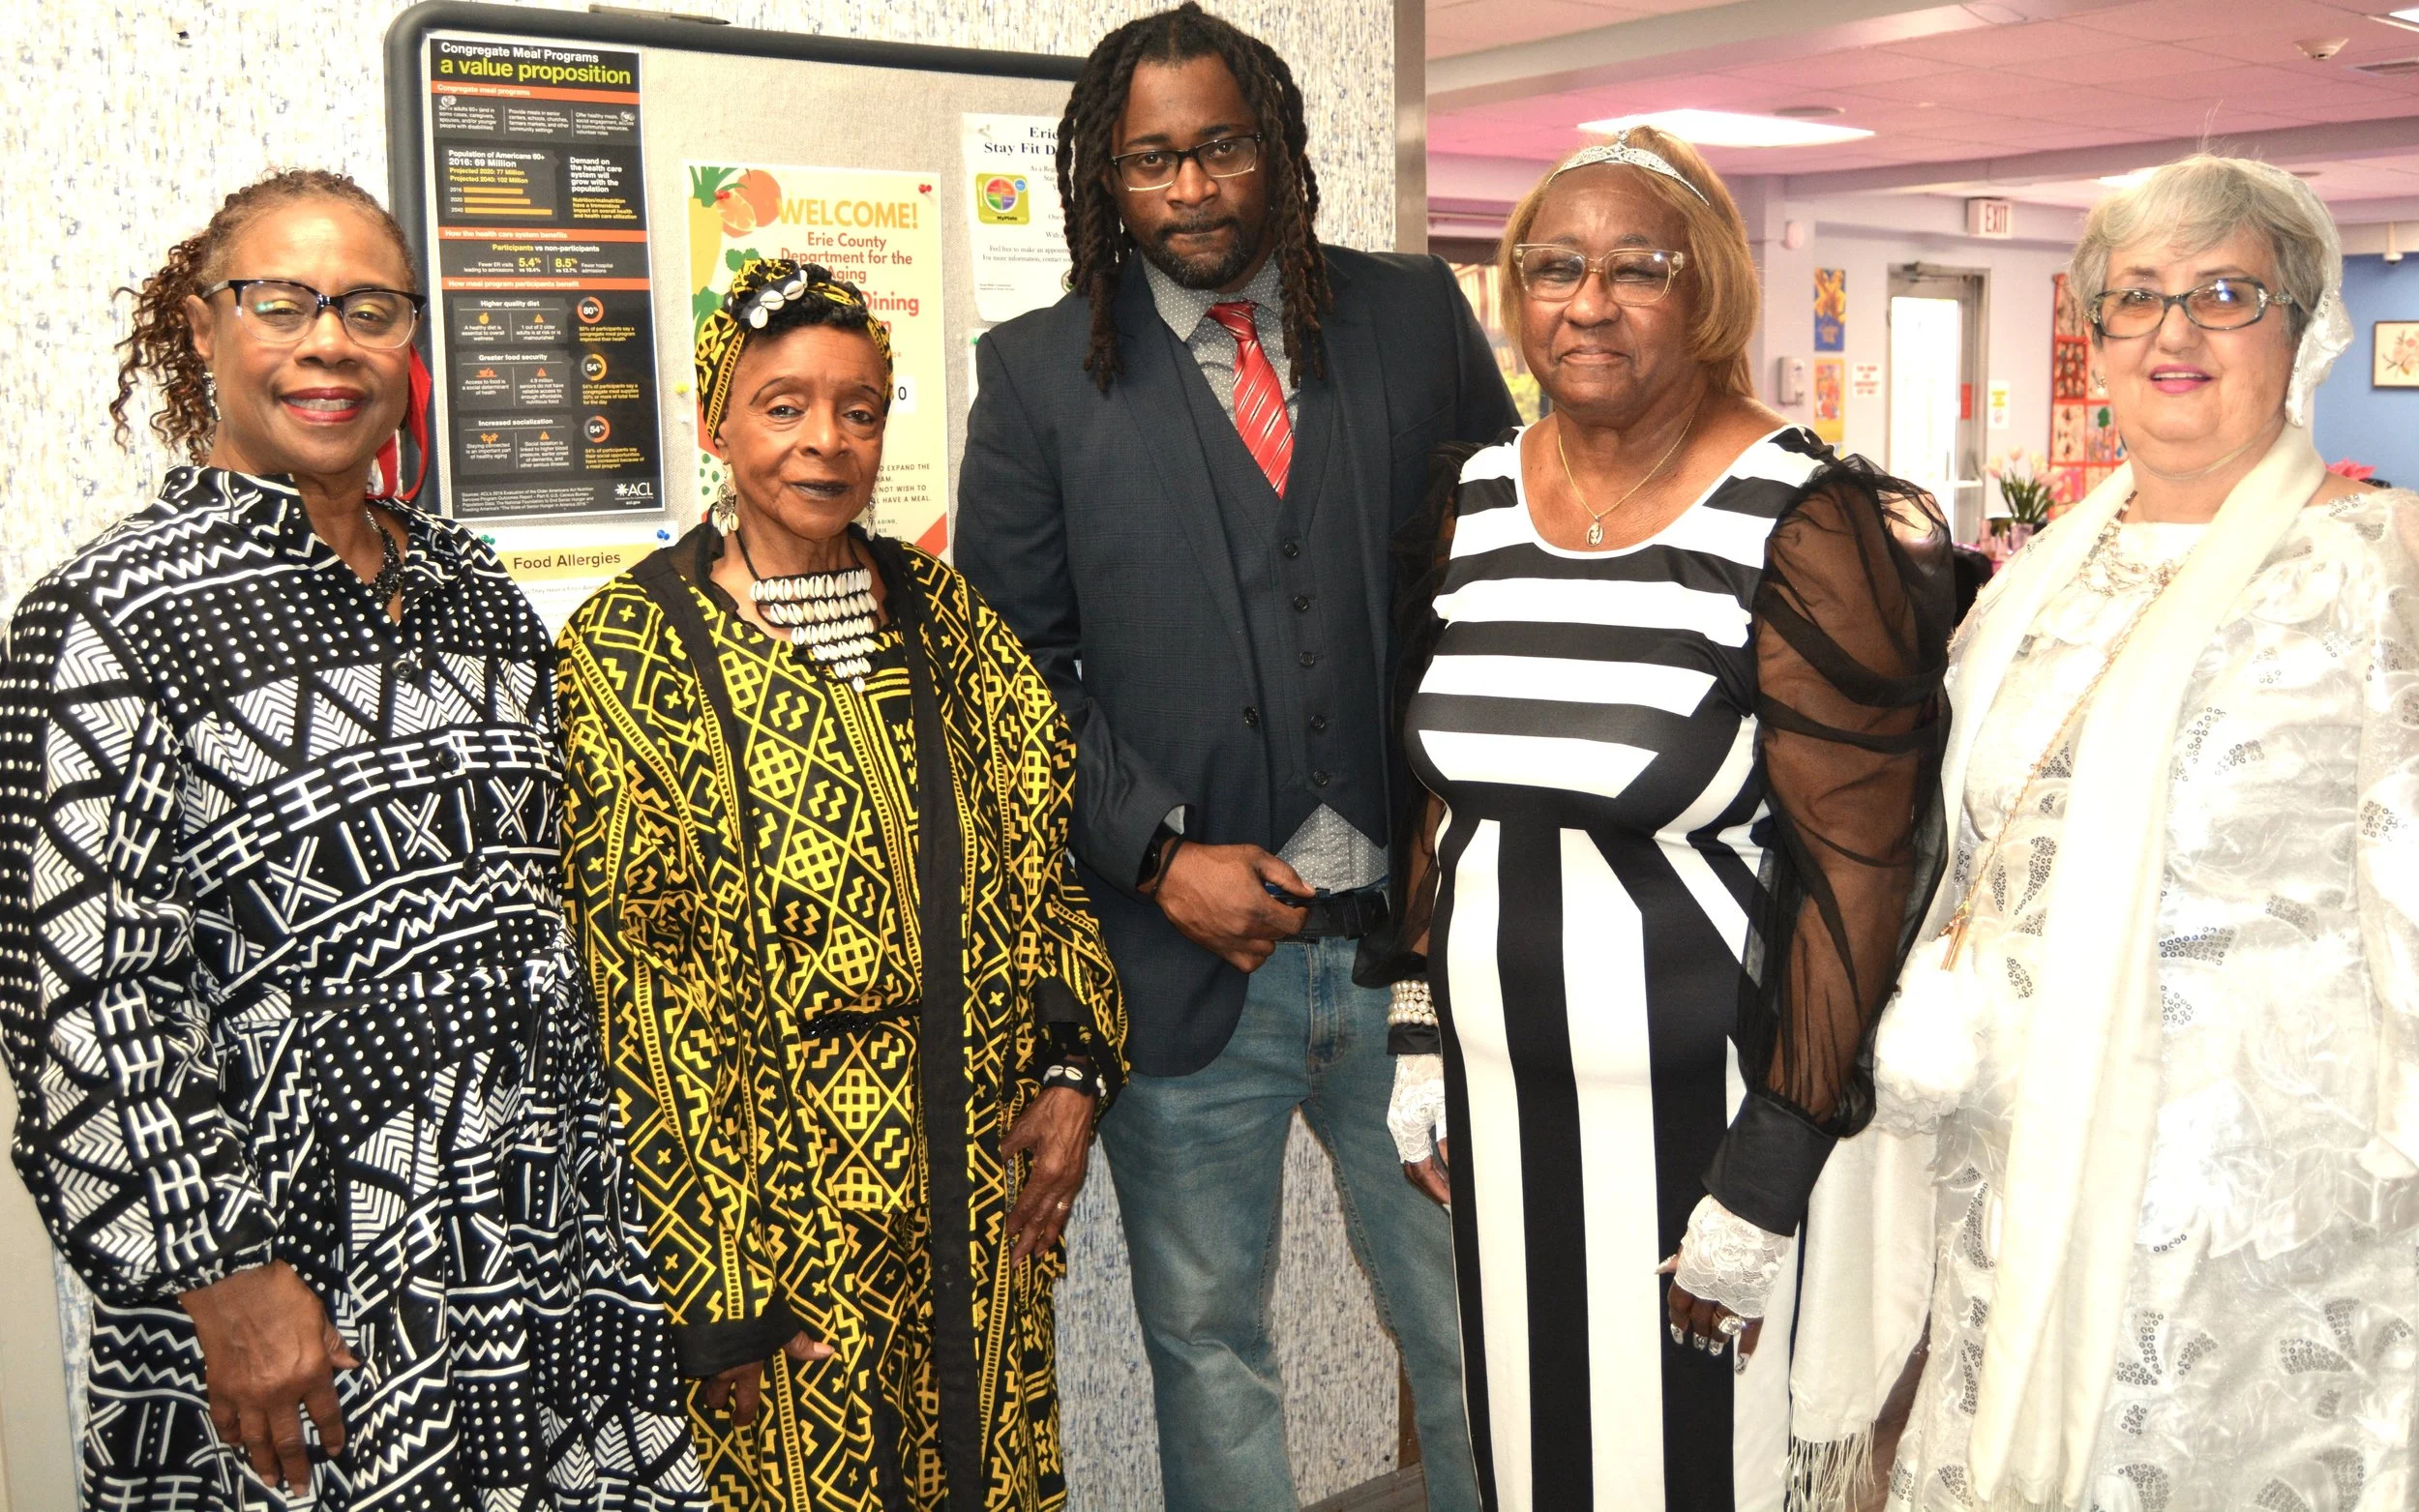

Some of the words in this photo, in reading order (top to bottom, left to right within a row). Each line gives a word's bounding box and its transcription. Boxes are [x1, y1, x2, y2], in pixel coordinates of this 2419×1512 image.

[441, 42, 511, 58] Congregate
[513, 47, 541, 59] Meal
[544, 49, 599, 63] Programs
[440, 59, 453, 74] a
[458, 57, 513, 77] value
[519, 64, 631, 84] proposition
[437, 84, 478, 94] Congregate
[448, 150, 486, 159] Population
[984, 142, 1015, 156] Stay
[1021, 143, 1040, 155] Fit
[488, 159, 517, 167] Million
[777, 198, 918, 229] WELCOME!
[1986, 205, 2009, 233] EXIT
[808, 232, 834, 246] Erie
[838, 233, 886, 252] County
[519, 257, 541, 267] 5.4%
[555, 257, 578, 268] 8.5%
[781, 248, 864, 264] Department
[868, 250, 887, 264] for
[892, 251, 912, 264] the
[828, 266, 866, 283] Aging
[582, 307, 598, 315] 80%
[586, 363, 602, 371] 54%
[589, 425, 605, 433] 54%
[627, 482, 653, 496] ACL
[513, 556, 552, 570] Food
[557, 552, 621, 568] Allergies
